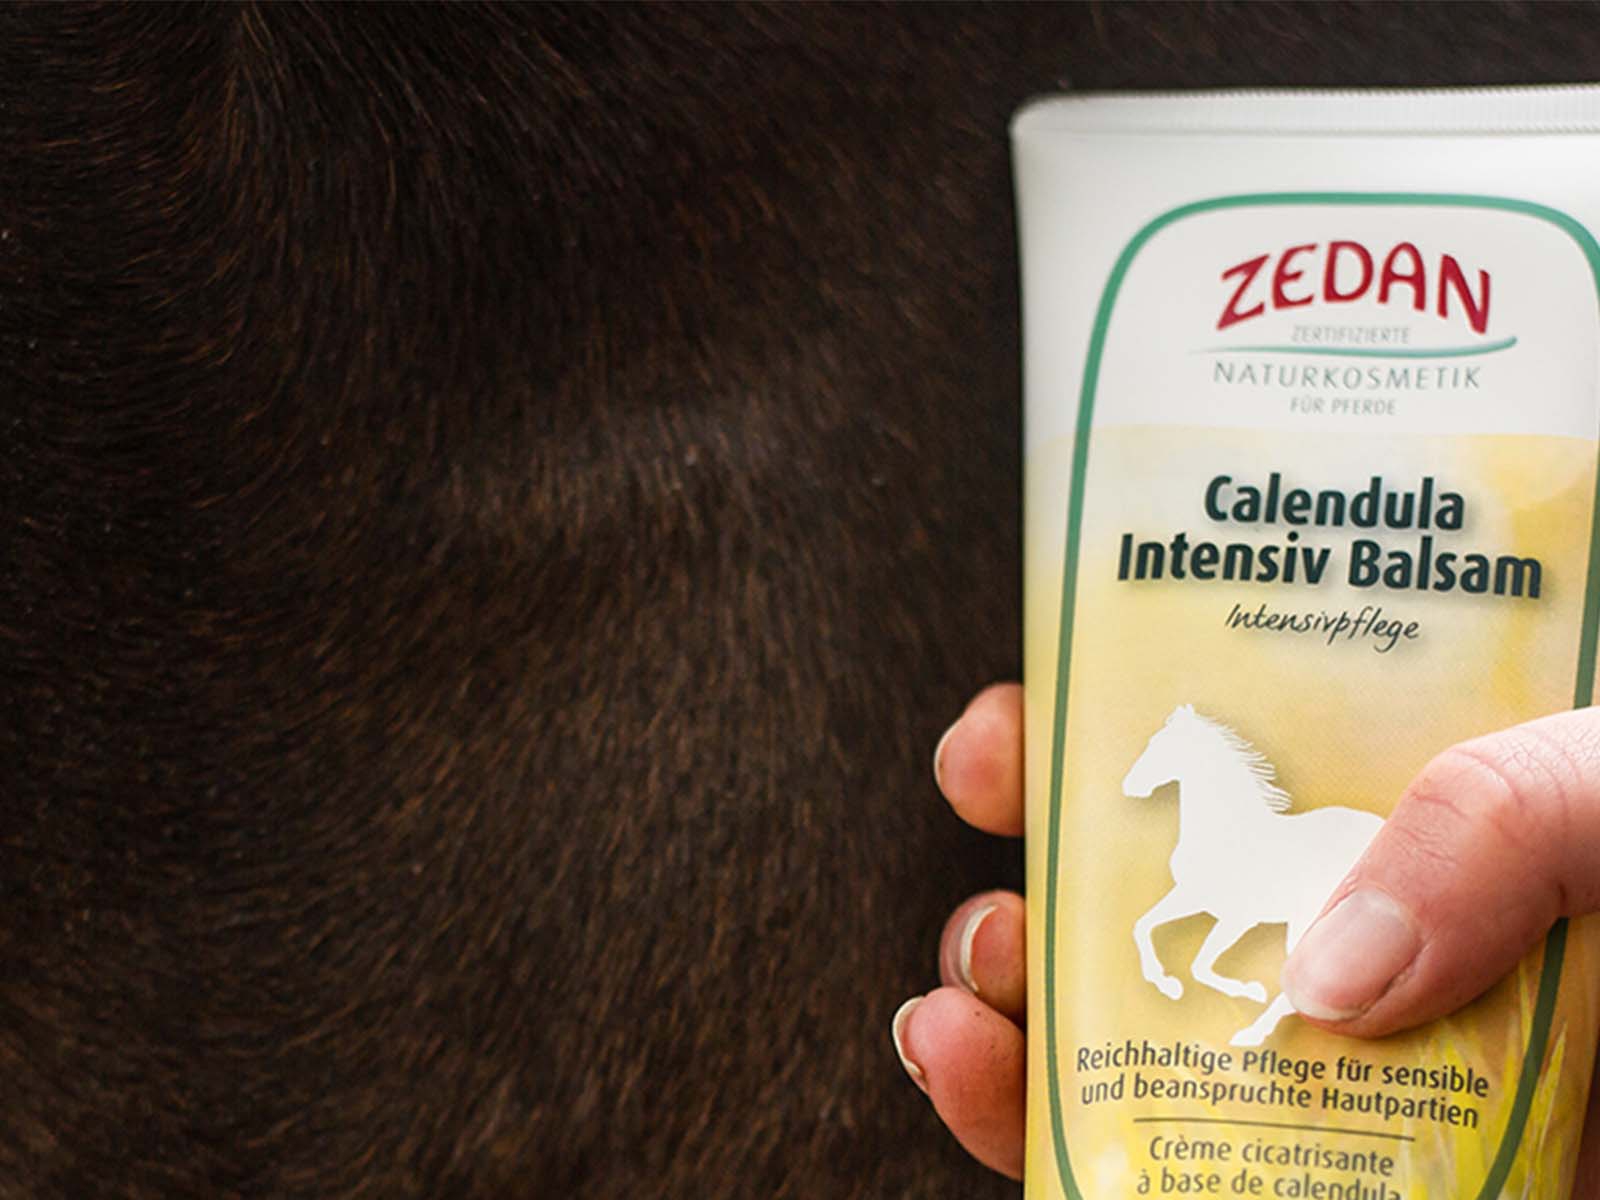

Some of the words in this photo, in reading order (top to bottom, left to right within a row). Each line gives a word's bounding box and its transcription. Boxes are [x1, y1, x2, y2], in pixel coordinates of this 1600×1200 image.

[1216, 240, 1491, 335] ZEDAN
[1291, 325, 1411, 344] ZERTIFIZIERTE
[1213, 361, 1482, 389] NATURKOSMETIK
[1290, 397, 1324, 413] FÜR
[1332, 398, 1397, 415] PFERDE
[1204, 473, 1465, 531] Calendula
[1117, 532, 1330, 584] Intensiv
[1349, 536, 1542, 598] Balsam
[1225, 604, 1419, 652] Intensivpflege
[1076, 1041, 1232, 1075] Reichhaltige
[1241, 1051, 1328, 1081] Pflege
[1336, 1057, 1376, 1082] für
[1382, 1060, 1489, 1098] sensible
[1081, 1074, 1126, 1105] und
[1133, 1074, 1312, 1109] beanspruchte
[1321, 1088, 1479, 1129] Hautpartien
[1149, 1135, 1232, 1162] Crème
[1241, 1136, 1395, 1176] cicatrisante
[1136, 1169, 1151, 1196] à
[1160, 1168, 1222, 1195] base
[1232, 1169, 1265, 1198] de
